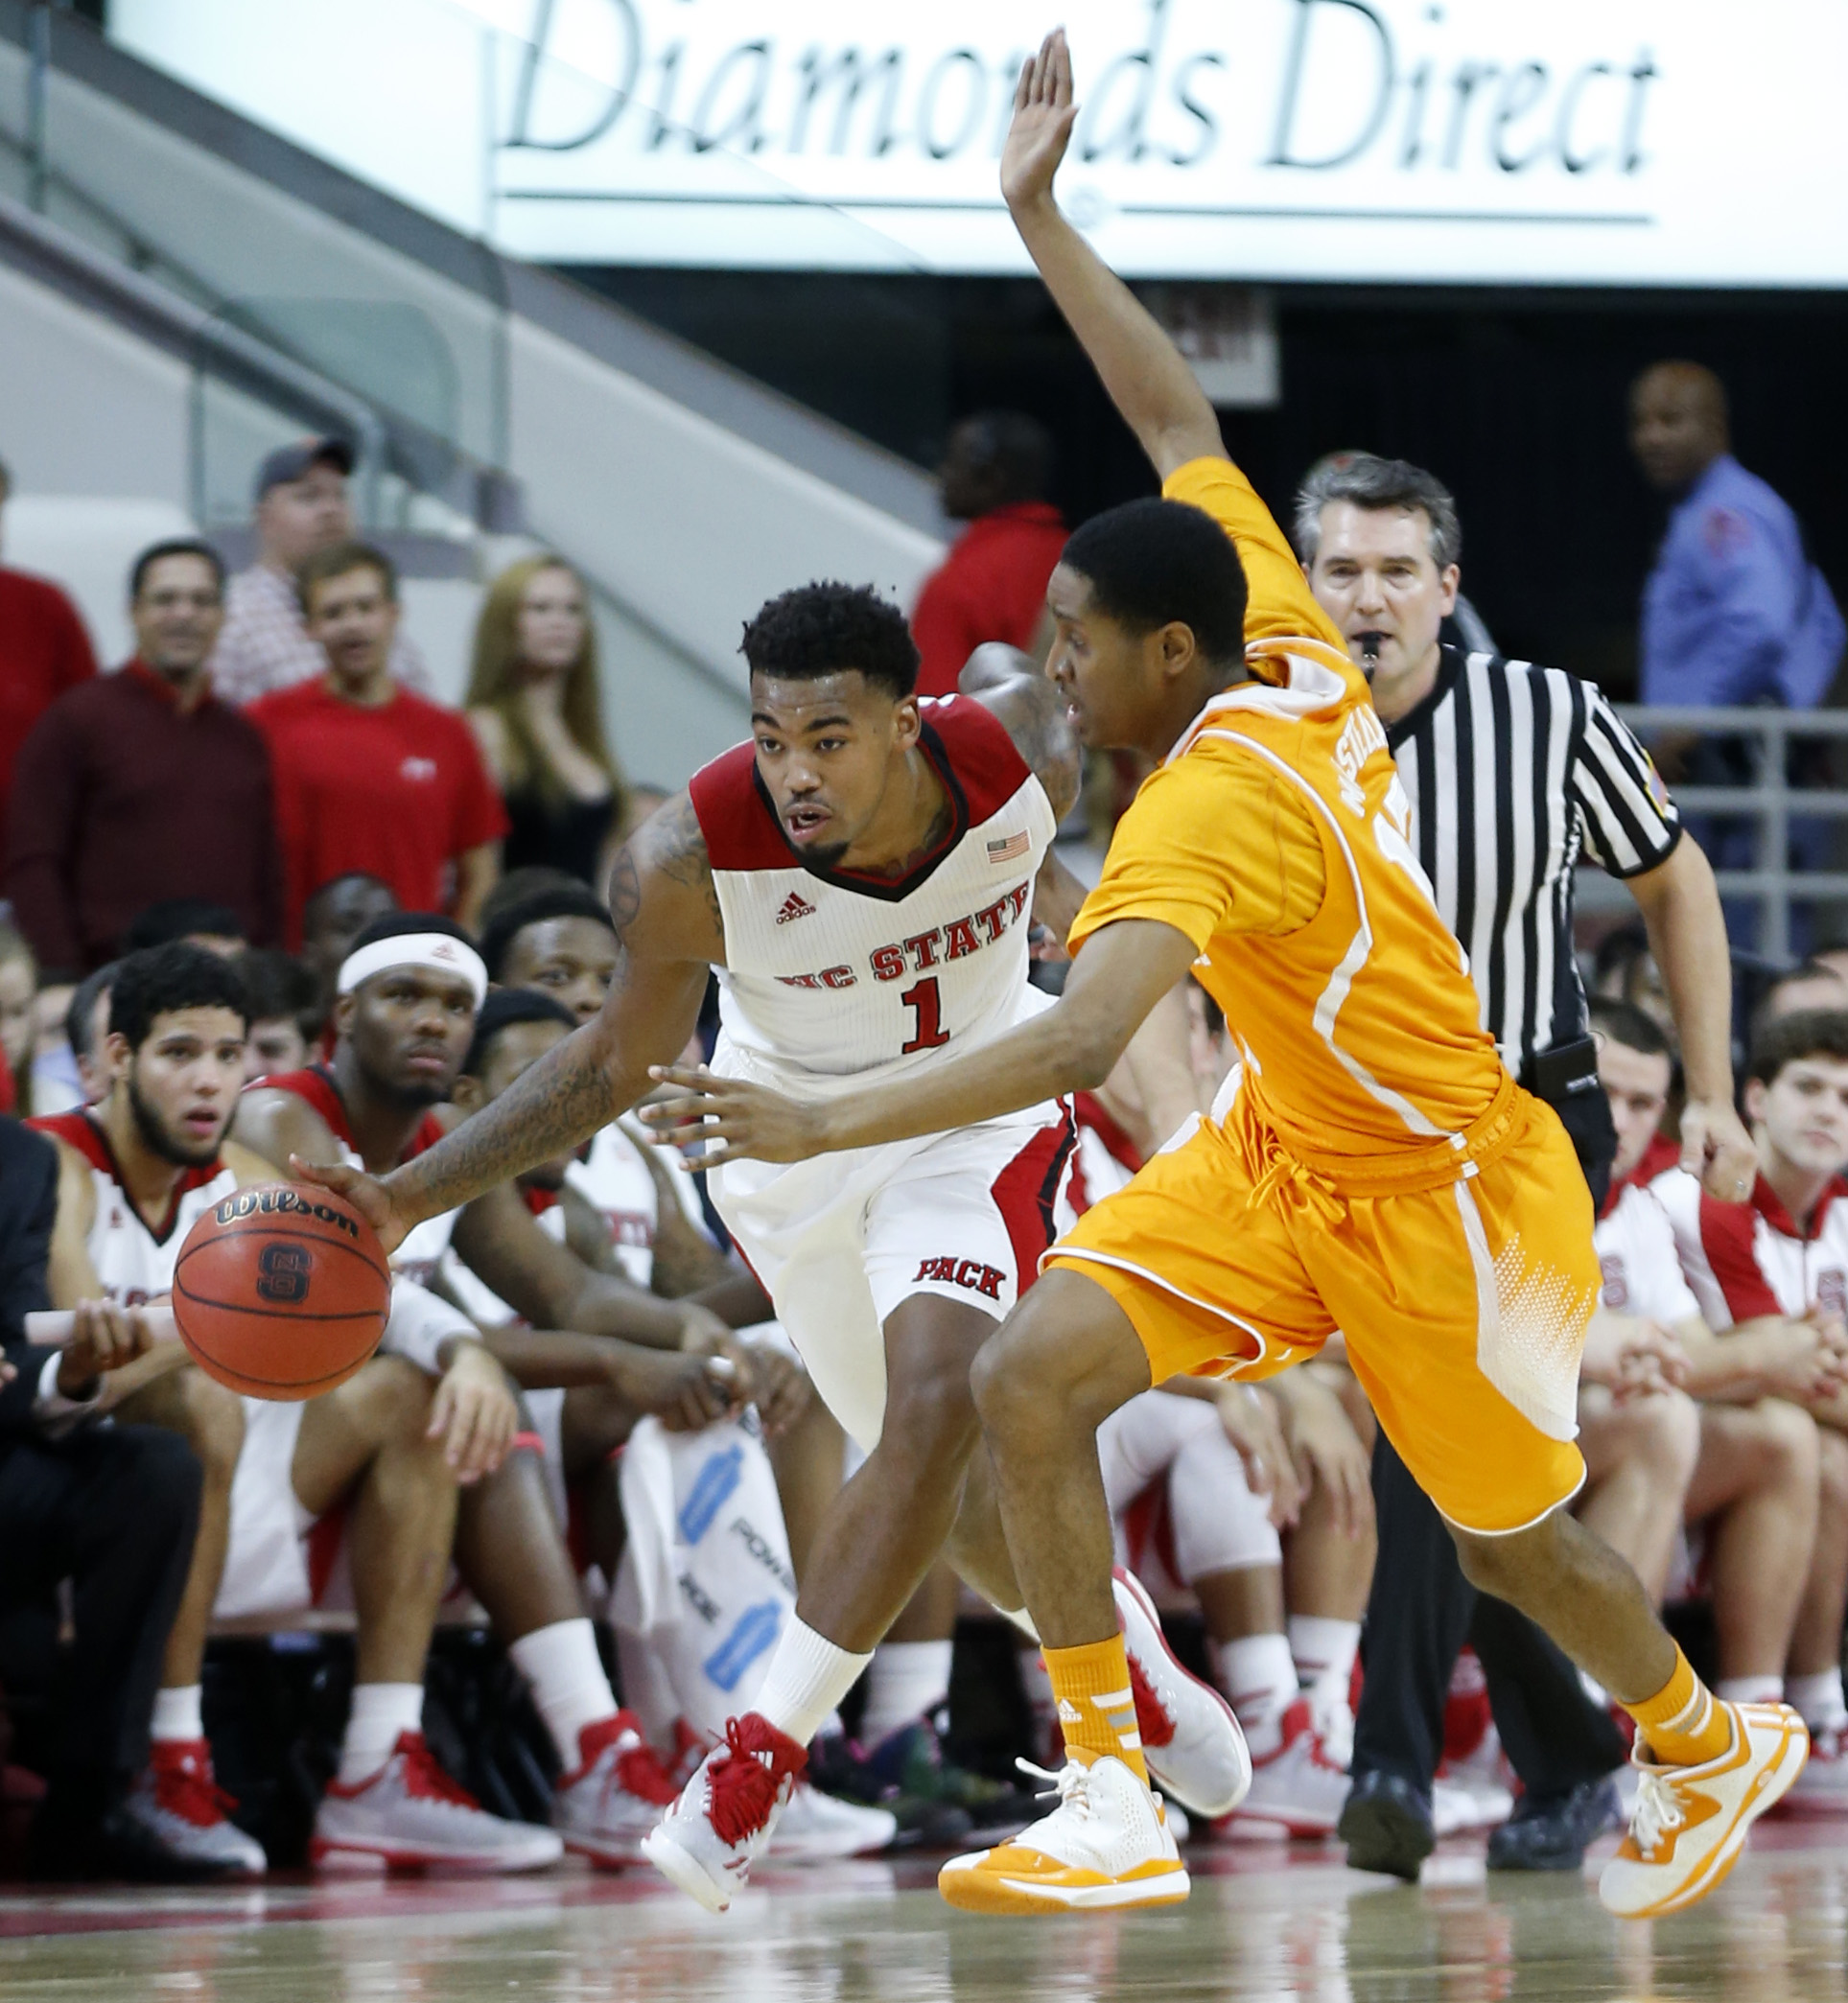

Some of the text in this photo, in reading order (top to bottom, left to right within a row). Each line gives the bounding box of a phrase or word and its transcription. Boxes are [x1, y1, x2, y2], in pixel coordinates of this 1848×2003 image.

[1259, 0, 1660, 174] Direct
[776, 904, 817, 924] adidas
[901, 976, 950, 1055] 1
[214, 1190, 359, 1240] Wilson
[912, 1256, 1006, 1301] PACK
